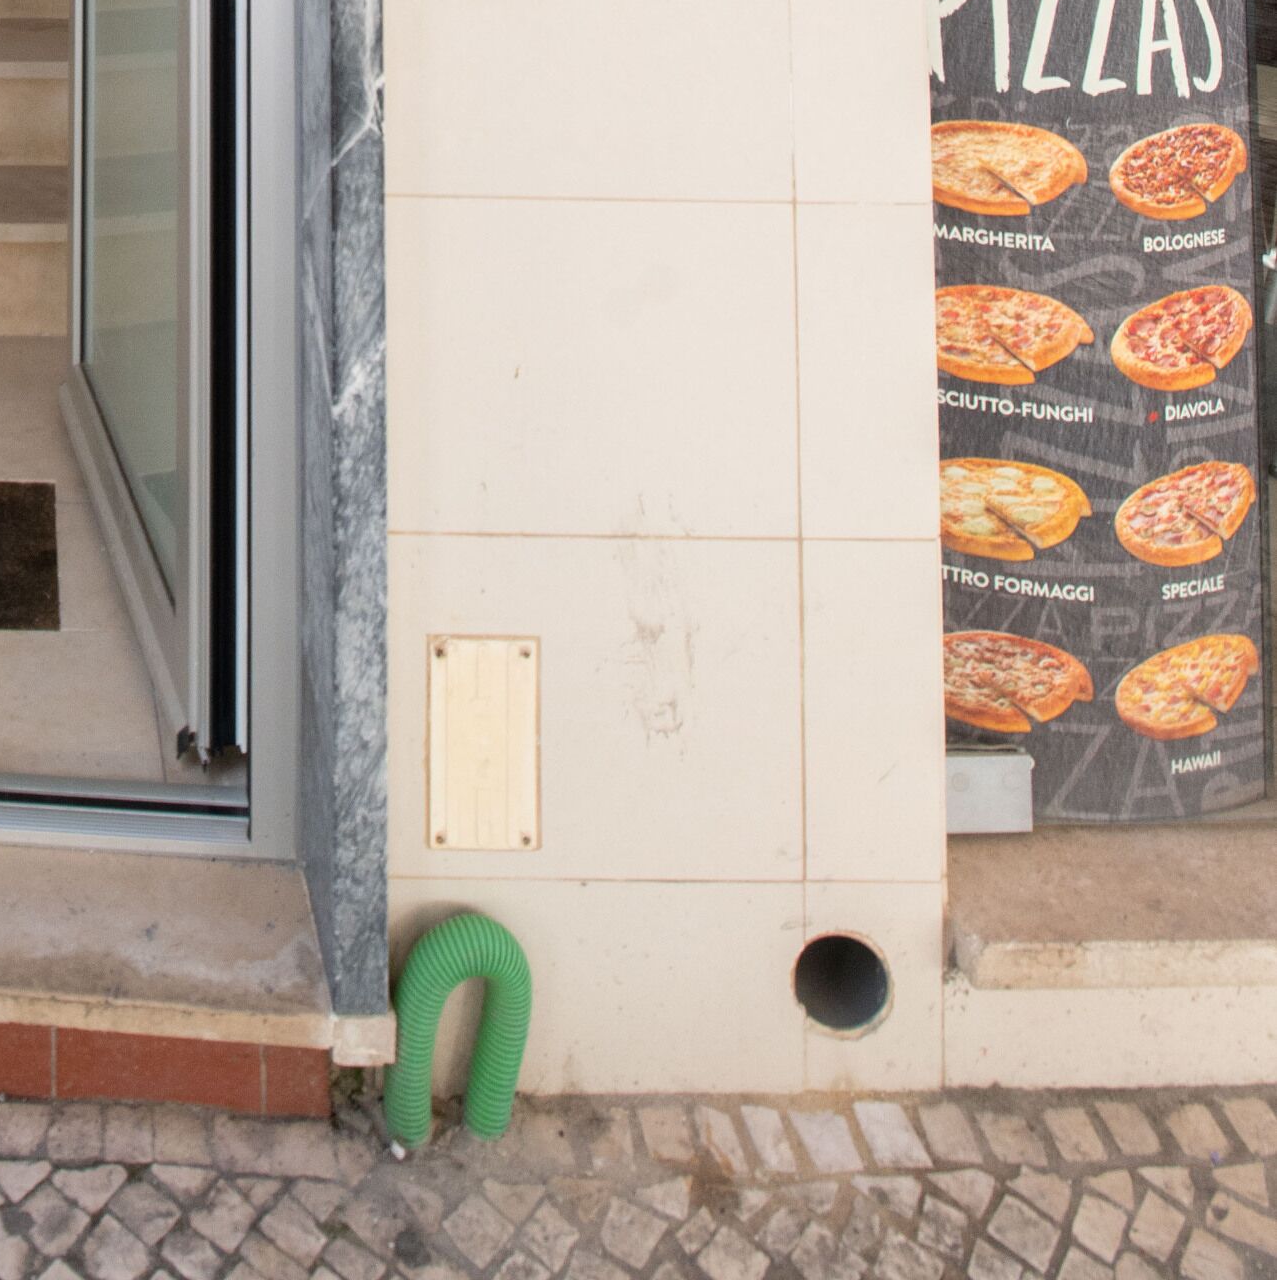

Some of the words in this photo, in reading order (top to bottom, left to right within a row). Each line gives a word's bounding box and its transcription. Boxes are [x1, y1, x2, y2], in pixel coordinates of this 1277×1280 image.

[933, 224, 1055, 253] MARGHERITA
[1143, 228, 1226, 253] BOLOGNESE
[1165, 398, 1225, 422] DIAVOLA
[994, 575, 1095, 603] FORMAGGI
[1161, 574, 1225, 601] SPECIALE
[1171, 750, 1222, 775] HAWAII
